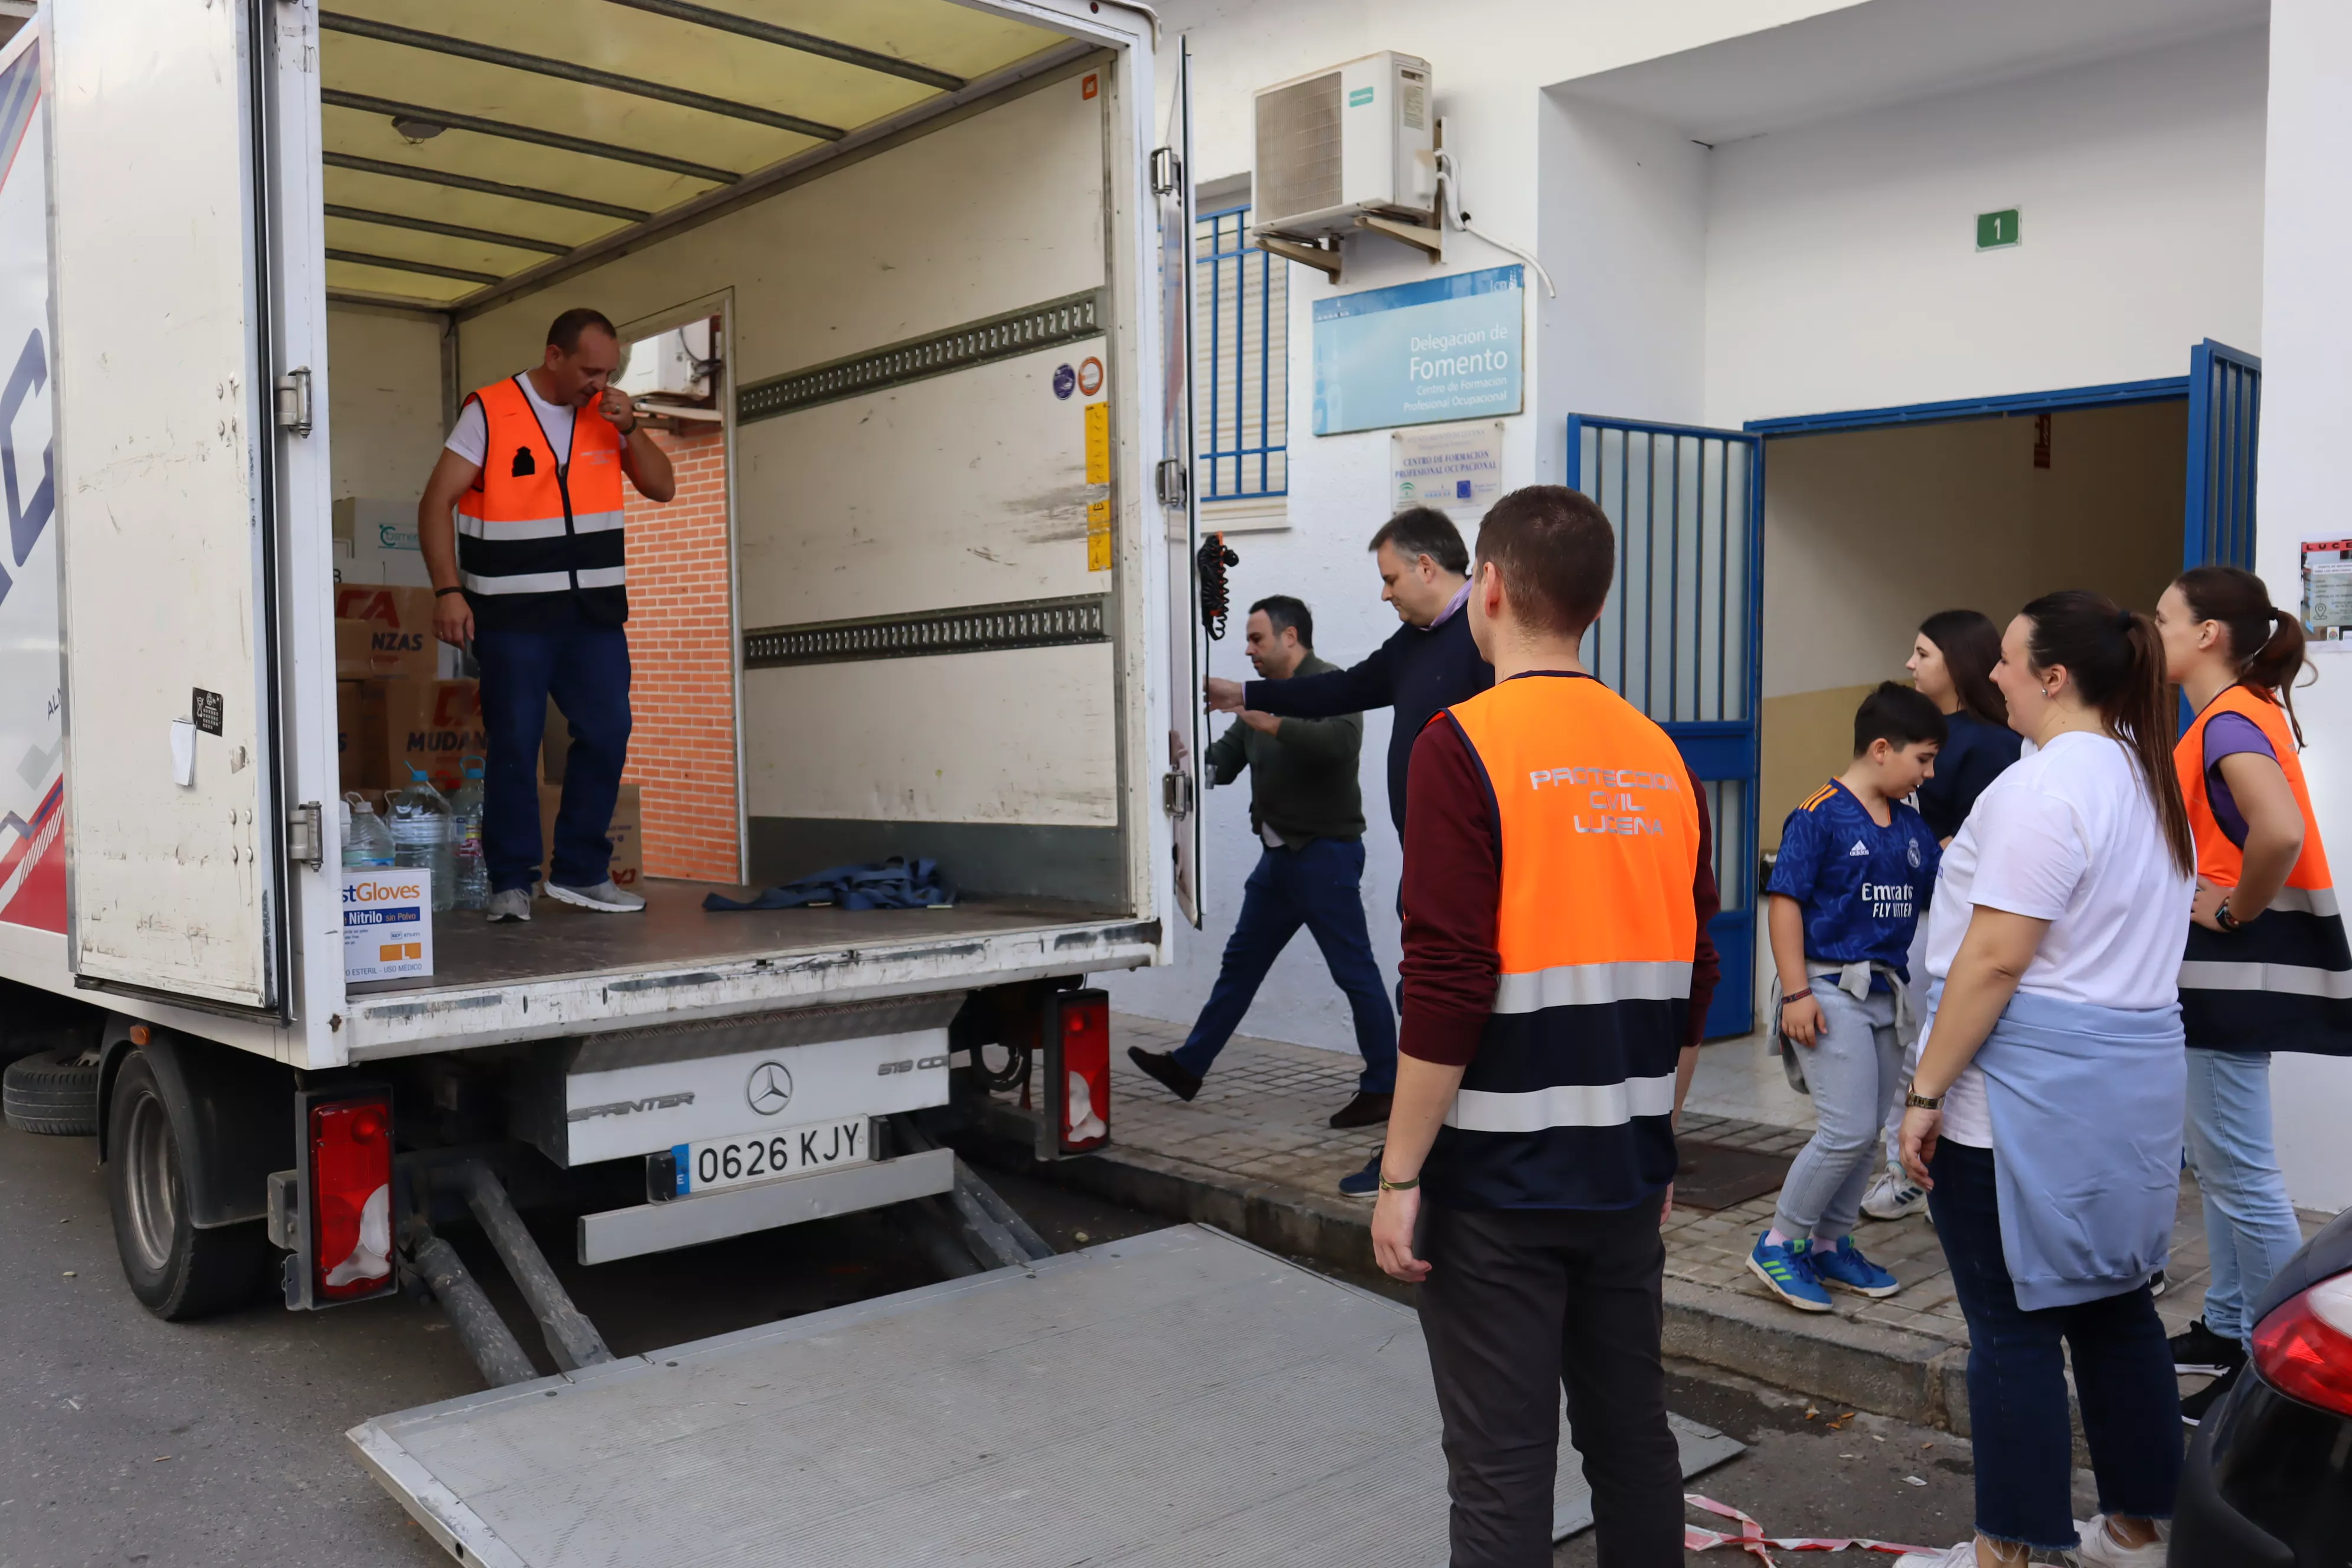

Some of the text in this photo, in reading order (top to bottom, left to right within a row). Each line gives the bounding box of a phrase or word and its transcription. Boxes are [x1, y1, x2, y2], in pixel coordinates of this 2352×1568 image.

[1994, 217, 2001, 240] 1
[1490, 323, 1508, 341] de
[1410, 348, 1508, 381] Fomento
[1416, 384, 1445, 396] Centro
[1447, 381, 1458, 392] de
[1404, 389, 1507, 412] Profesional Ocupacional
[1395, 460, 1496, 479] PROFESIONAL OCUPACIONAL
[1403, 456, 1432, 466] CENTRO
[1433, 454, 1443, 463] DE
[1530, 767, 1680, 793] PROTECCION
[1574, 815, 1664, 837] LUCENA
[349, 910, 416, 925] Nitrilo sin Polvo
[1873, 902, 1891, 918] FLY
[401, 944, 410, 959] L
[352, 968, 377, 976] ESTERIL
[567, 1092, 695, 1123] SPRINTER
[677, 1122, 859, 1184] E 0626 KJY
